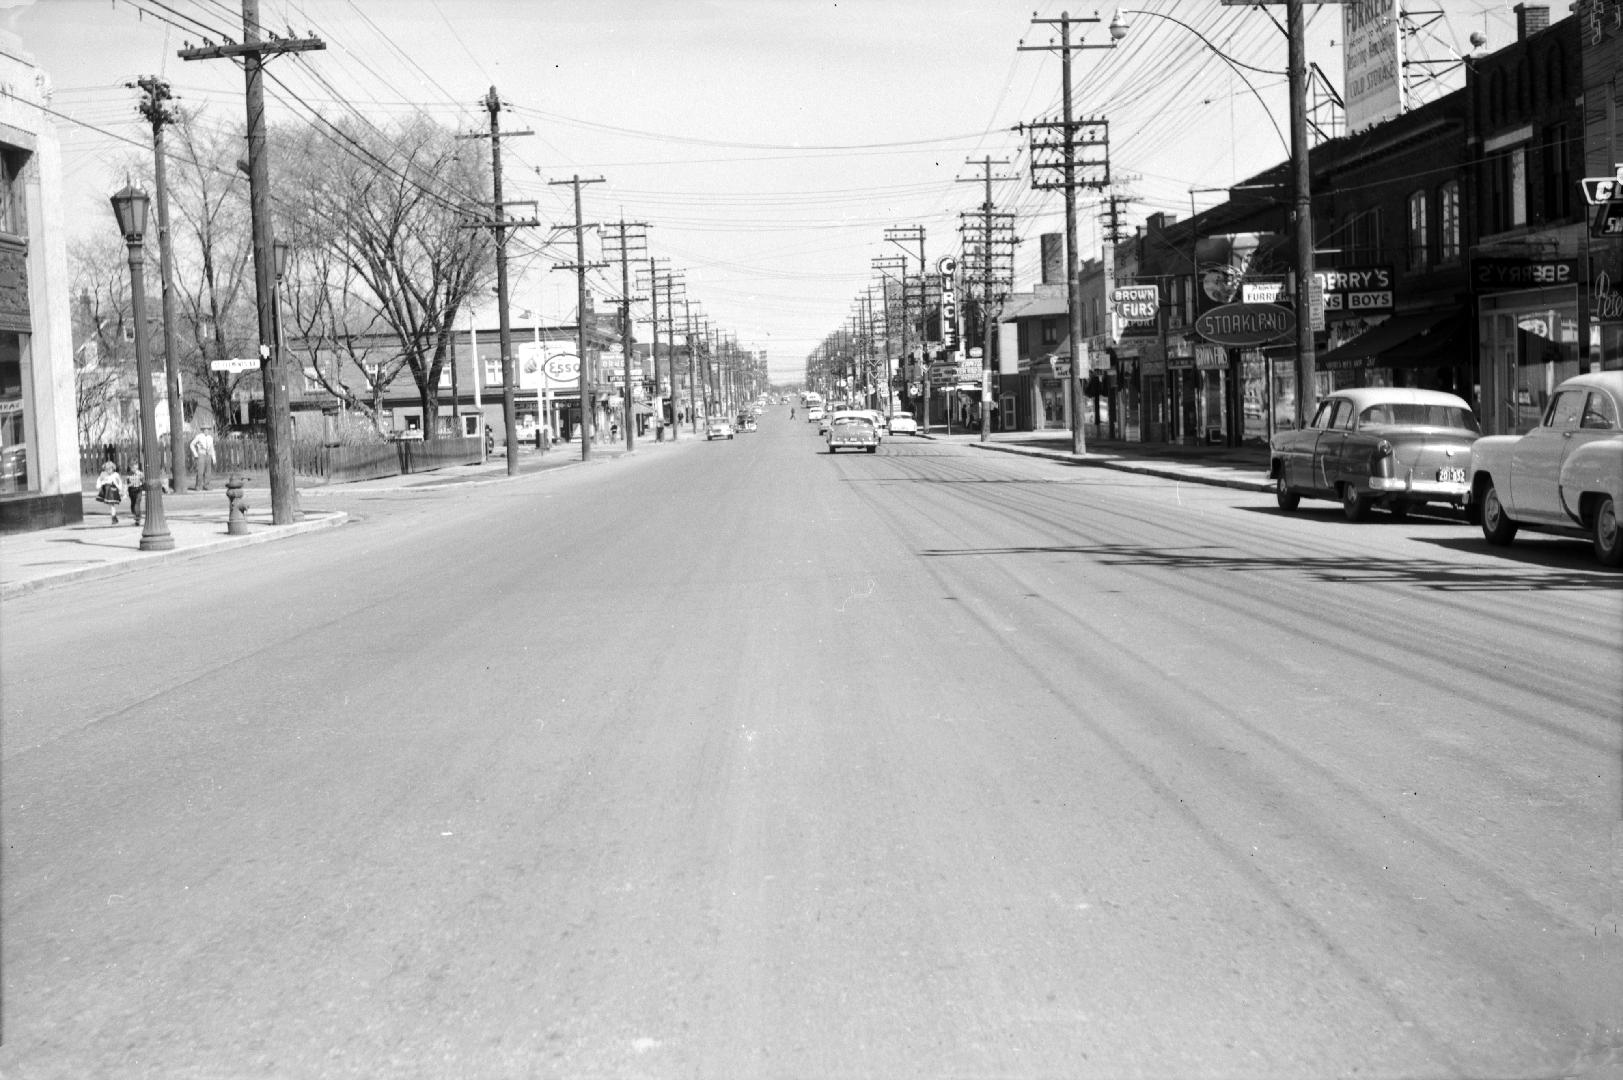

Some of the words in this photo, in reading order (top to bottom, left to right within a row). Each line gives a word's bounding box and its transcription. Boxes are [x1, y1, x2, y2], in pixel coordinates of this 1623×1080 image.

[941, 258, 955, 346] CIRCLE
[1115, 290, 1154, 301] BROWN
[1351, 294, 1390, 307] BOYS
[1122, 302, 1154, 317] FURS
